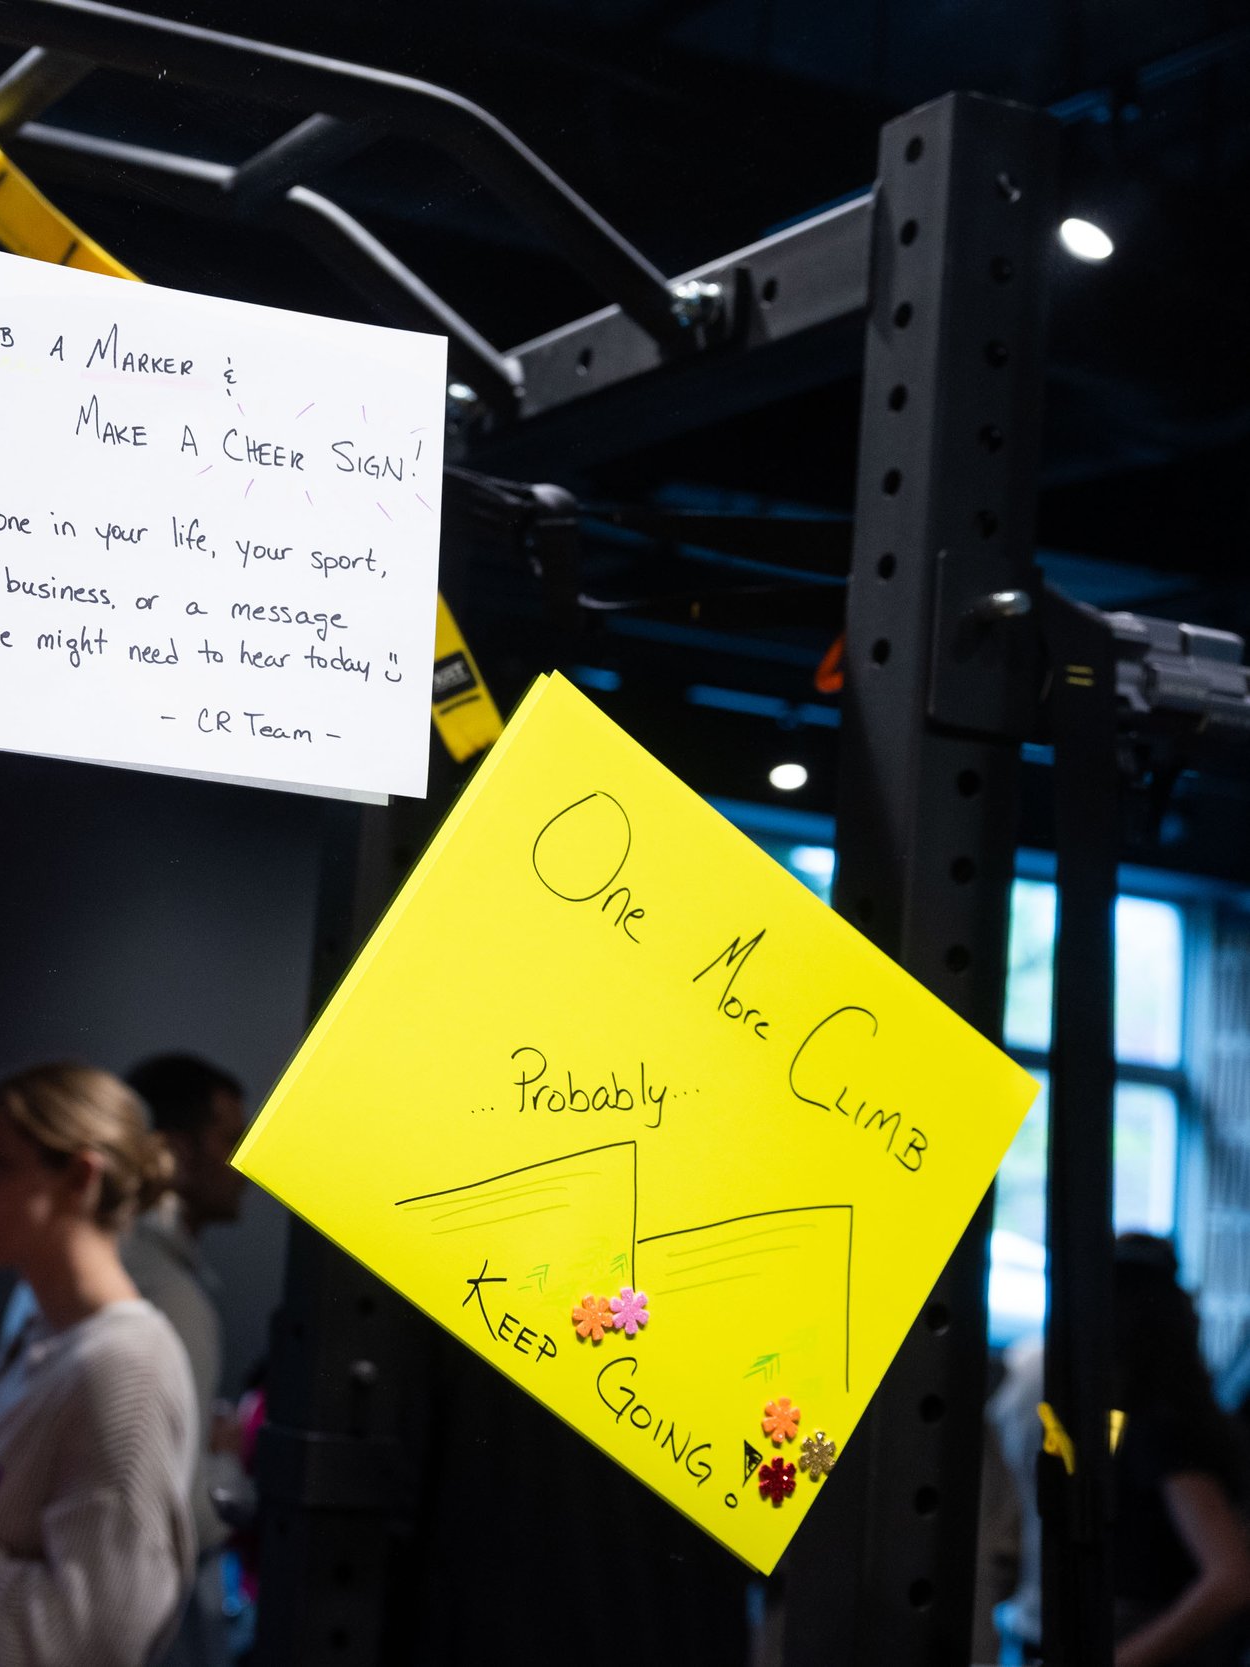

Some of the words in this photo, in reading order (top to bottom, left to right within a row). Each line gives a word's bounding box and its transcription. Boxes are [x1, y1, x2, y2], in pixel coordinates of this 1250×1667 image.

[75, 394, 148, 447] MAKE
[222, 428, 304, 472] CHEER
[50, 511, 77, 537] in
[94, 522, 149, 551] your
[172, 516, 216, 559] life,
[235, 540, 293, 569] your
[310, 547, 387, 579] sport,
[135, 594, 160, 610] or
[185, 601, 208, 616] a
[231, 600, 348, 640] message
[37, 625, 108, 669] might
[129, 637, 179, 665] need
[197, 638, 224, 664] to
[240, 639, 291, 669] hear
[303, 645, 371, 682] today
[197, 707, 232, 733] CR
[243, 711, 312, 744] Team
[532, 791, 645, 944] One
[692, 928, 770, 1041] More
[788, 1005, 928, 1173] CLIMB
[462, 1259, 558, 1362] KEEP
